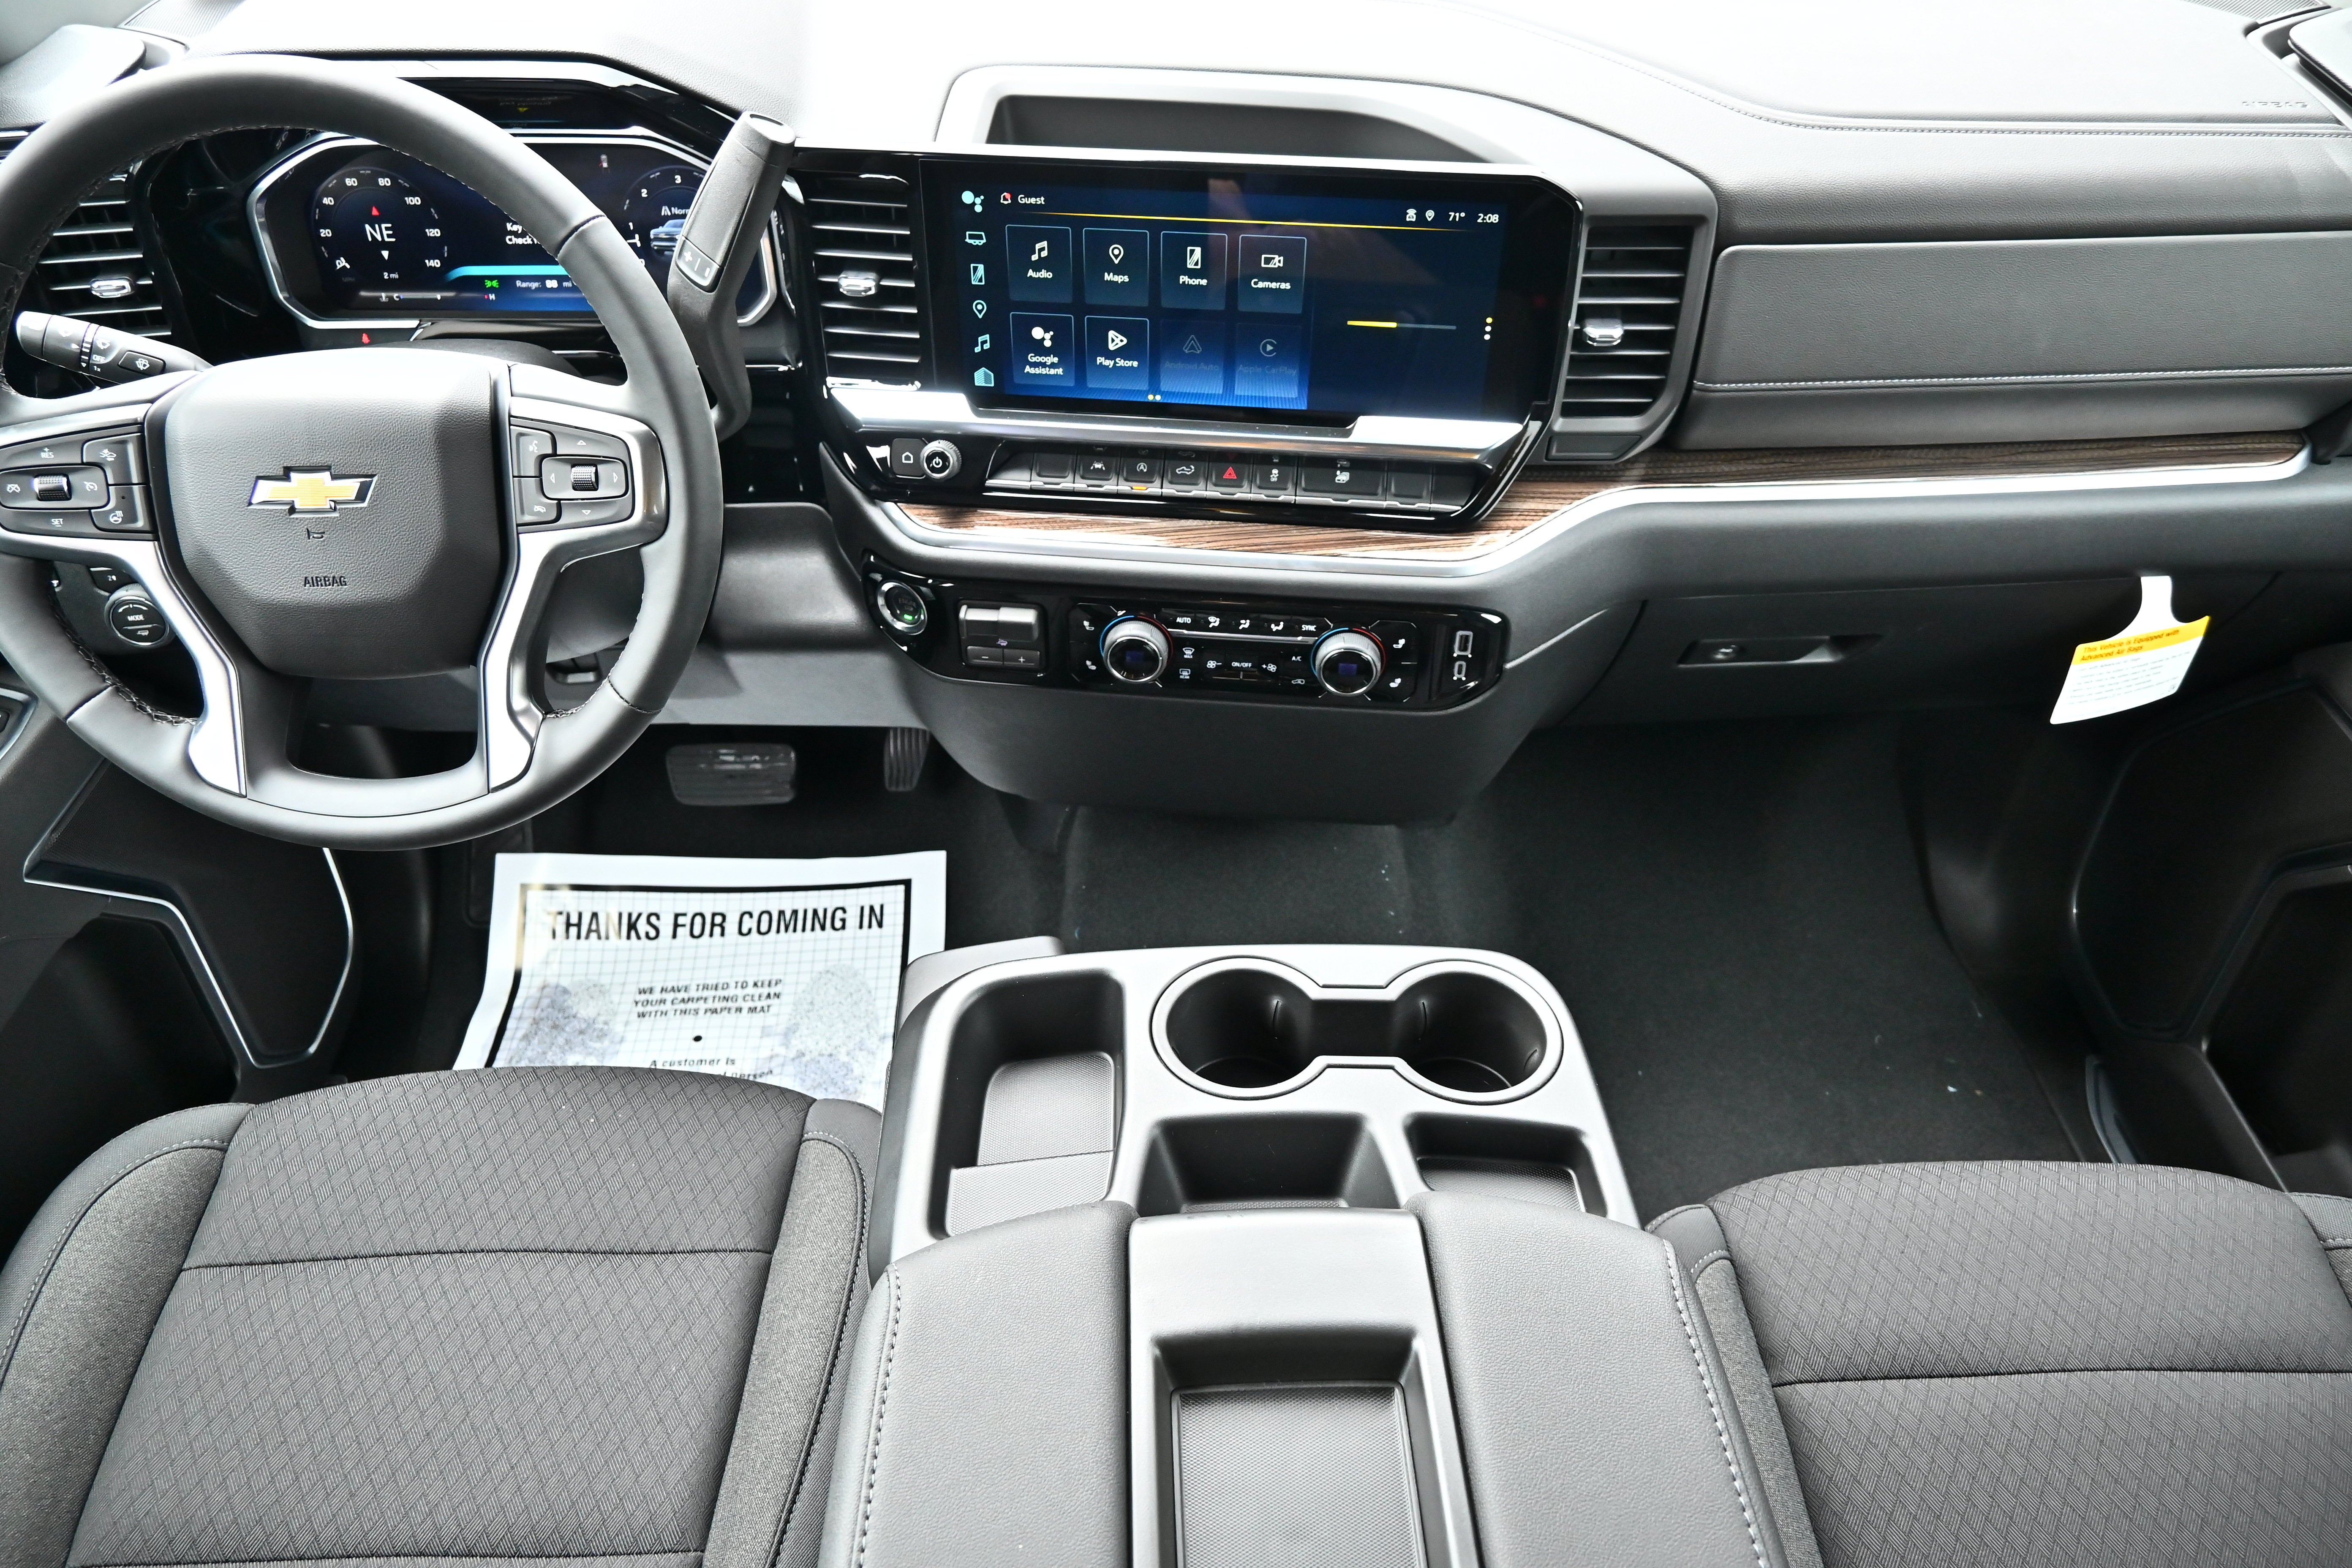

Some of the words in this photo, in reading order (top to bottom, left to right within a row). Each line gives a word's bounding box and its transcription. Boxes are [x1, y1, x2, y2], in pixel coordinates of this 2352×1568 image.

[346, 177, 358, 187] 60
[378, 177, 391, 187] 80
[675, 175, 682, 184] 3
[641, 188, 648, 198] 2
[322, 196, 335, 206] 40
[404, 196, 421, 206] 100
[1018, 194, 1045, 205] Guest
[671, 207, 690, 215] Nor
[1448, 212, 1465, 221] 71°
[1477, 213, 1499, 223] 2:08
[506, 222, 523, 234] Key
[629, 222, 634, 231] 1
[320, 229, 332, 238] 20
[364, 223, 396, 242] NE
[425, 229, 441, 237] 120
[506, 235, 533, 245] Check
[425, 259, 441, 268] 140
[1027, 269, 1053, 279] Audio
[1104, 272, 1129, 283] Maps
[516, 280, 542, 290] Range:
[1179, 275, 1208, 286] Phone
[1251, 279, 1291, 290] Cameras
[93, 354, 106, 362] OFF
[1028, 354, 1059, 365] Google
[1097, 357, 1115, 368] Play
[1116, 358, 1138, 368] Store
[1024, 365, 1063, 376] Assistant
[1199, 362, 1219, 371] Auto
[1239, 364, 1262, 374] Apple
[1265, 366, 1297, 376] CarPlay
[304, 576, 348, 588] AIRBAG
[1302, 624, 1317, 632] SYNC
[2100, 641, 2124, 651] Vehicle
[2133, 633, 2164, 643] Equipped
[2080, 651, 2114, 662] Advanced
[2127, 645, 2143, 653] Bags
[547, 911, 661, 940] THANKS
[672, 912, 726, 939] FOR
[738, 906, 847, 936] COMING
[858, 904, 884, 930] IN
[637, 985, 655, 995] WE
[660, 983, 691, 994] HAVE
[696, 981, 729, 992] TRIED
[734, 980, 749, 990] TO
[752, 978, 782, 989] KEEP
[634, 998, 667, 1007] YOUR
[670, 994, 739, 1006] CARPETING
[742, 991, 781, 1002] CLEAN
[637, 1009, 668, 1018] WITH
[673, 1007, 700, 1016] THIS
[703, 1005, 743, 1015] PAPER
[747, 1003, 772, 1014] MAT
[650, 1060, 657, 1070] A
[662, 1057, 721, 1067] customer
[726, 1057, 736, 1066] is
